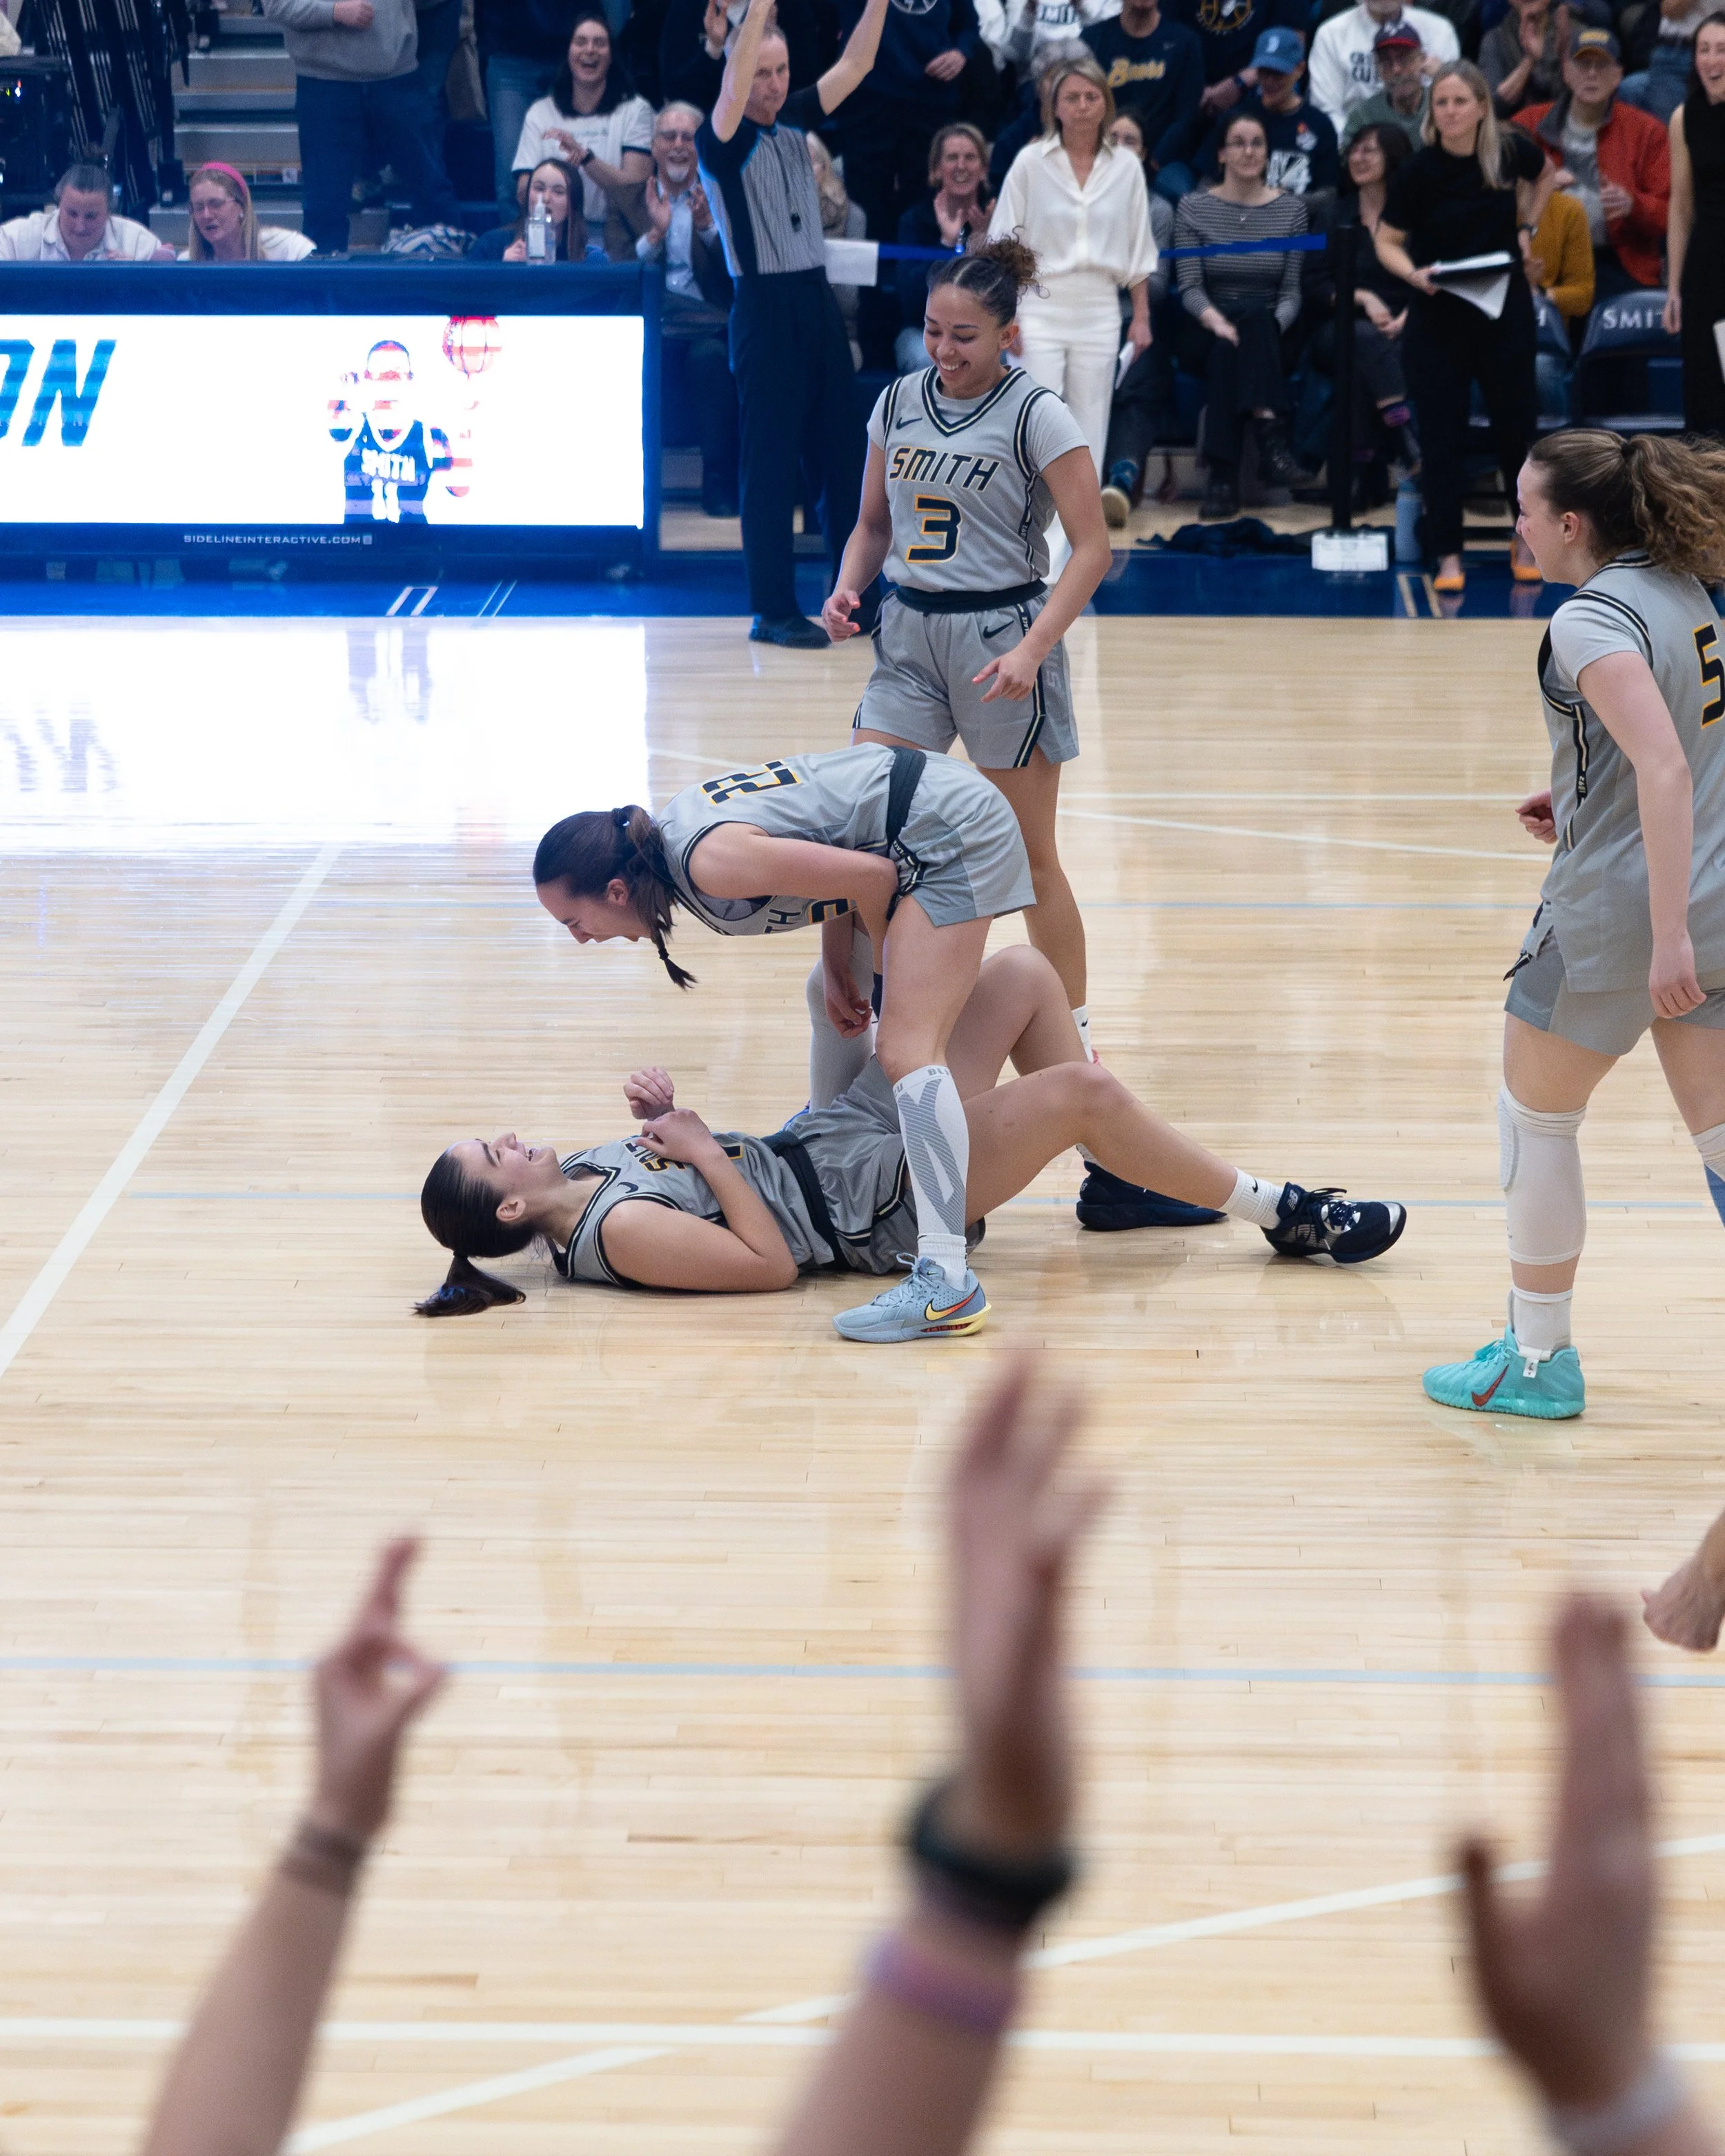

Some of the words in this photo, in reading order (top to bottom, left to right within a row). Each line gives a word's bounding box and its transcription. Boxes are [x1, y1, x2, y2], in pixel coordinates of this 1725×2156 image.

[1603, 308, 1663, 328] SMI
[889, 446, 1000, 493] SMITH
[184, 535, 361, 544] SIDELINEINTERACTIVE.COM
[905, 493, 963, 564] 3
[1693, 622, 1725, 729] 5
[700, 759, 801, 806] 22
